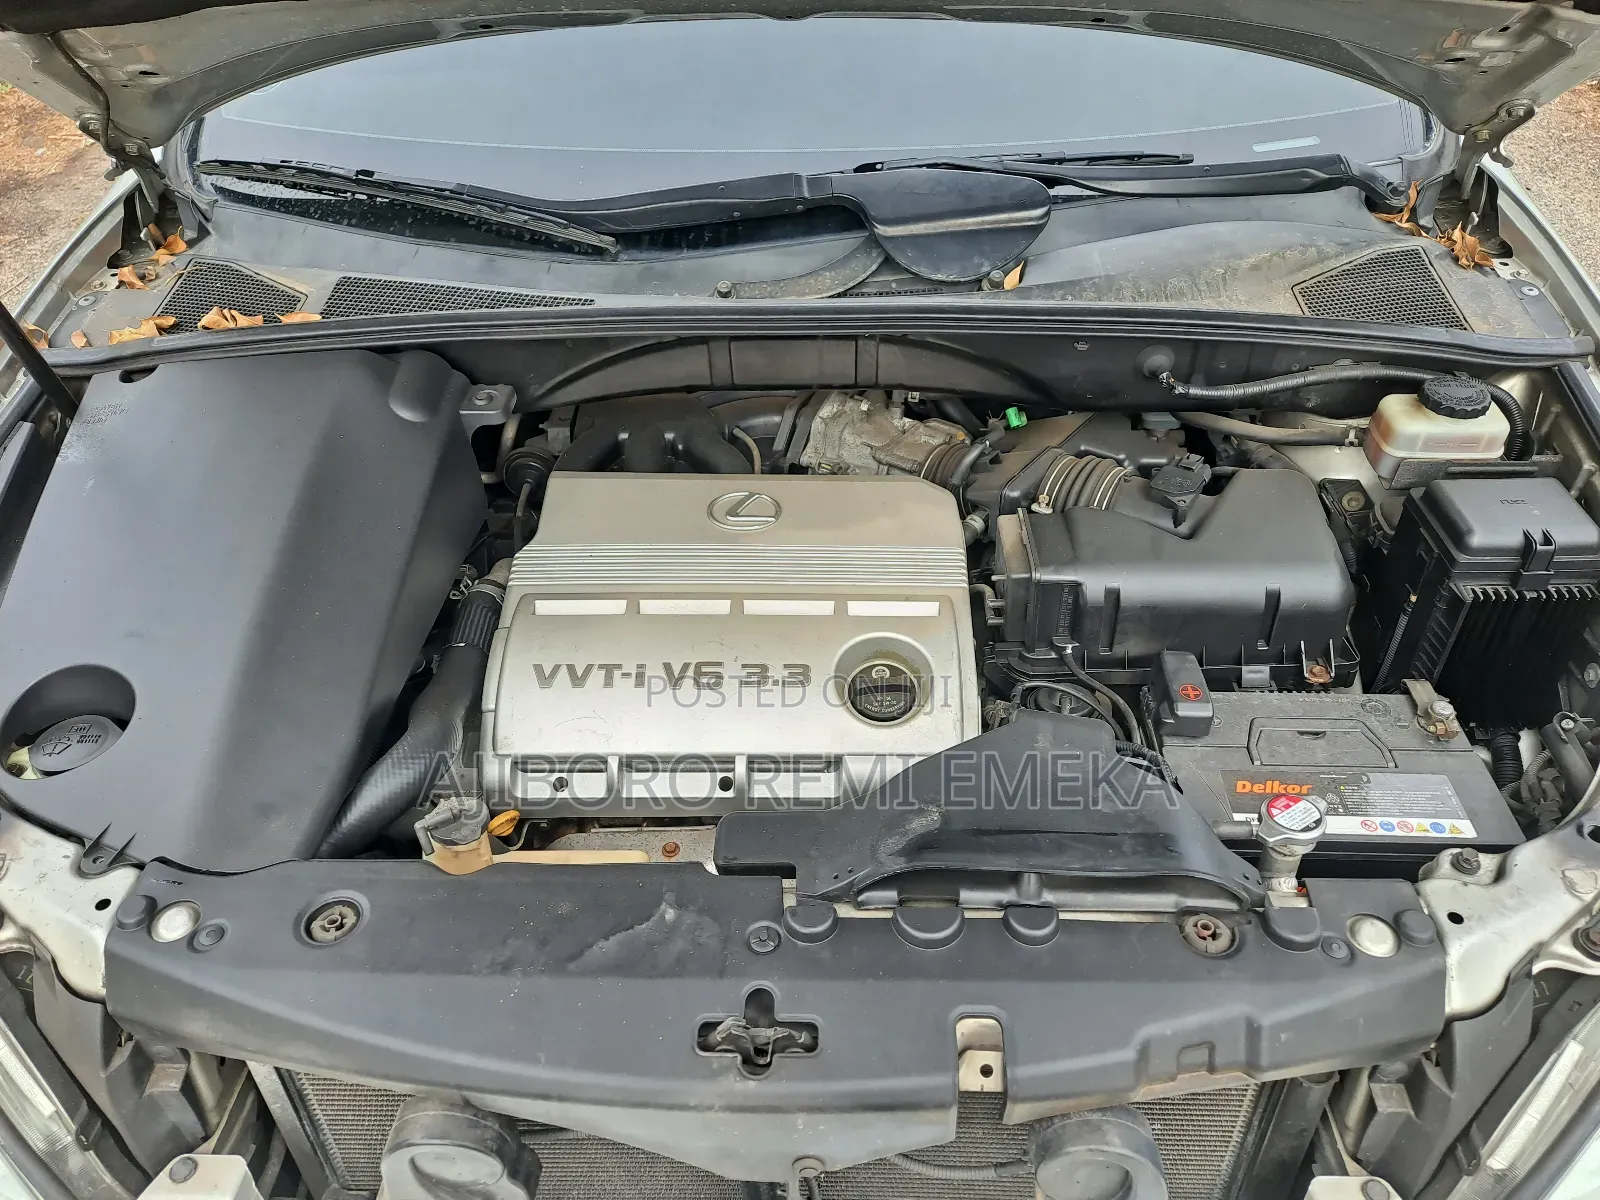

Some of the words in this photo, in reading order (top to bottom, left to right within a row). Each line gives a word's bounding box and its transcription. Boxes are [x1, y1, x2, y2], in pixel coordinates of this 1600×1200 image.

[532, 663, 647, 689] VVT-i
[661, 661, 725, 690] V6
[740, 663, 812, 688] 3.3
[1235, 780, 1313, 795] Delkor
